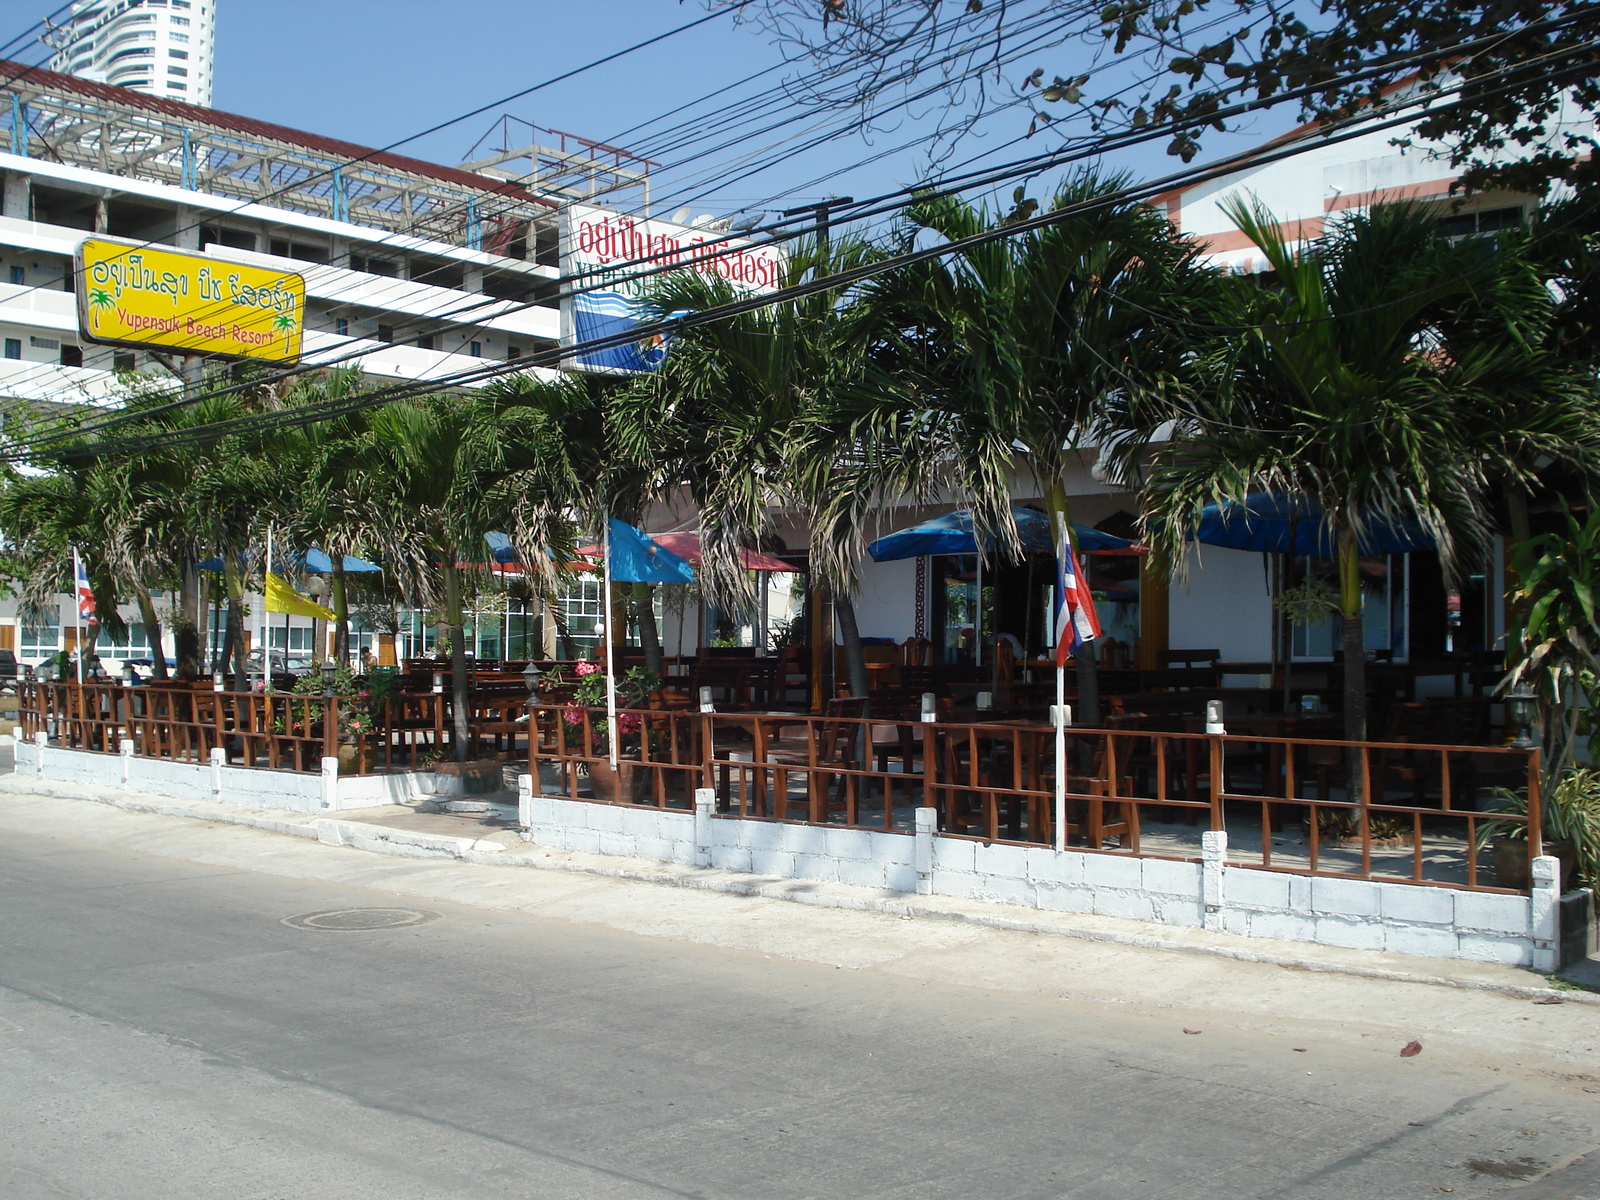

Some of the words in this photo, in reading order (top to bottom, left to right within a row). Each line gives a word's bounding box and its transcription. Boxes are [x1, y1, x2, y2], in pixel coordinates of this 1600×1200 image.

[93, 255, 188, 305] อยู่เป็นสุข
[228, 273, 296, 312] รีสอร์ท
[117, 307, 181, 333] Yupensuk
[186, 317, 227, 340] Beach
[232, 323, 275, 346] Resort
